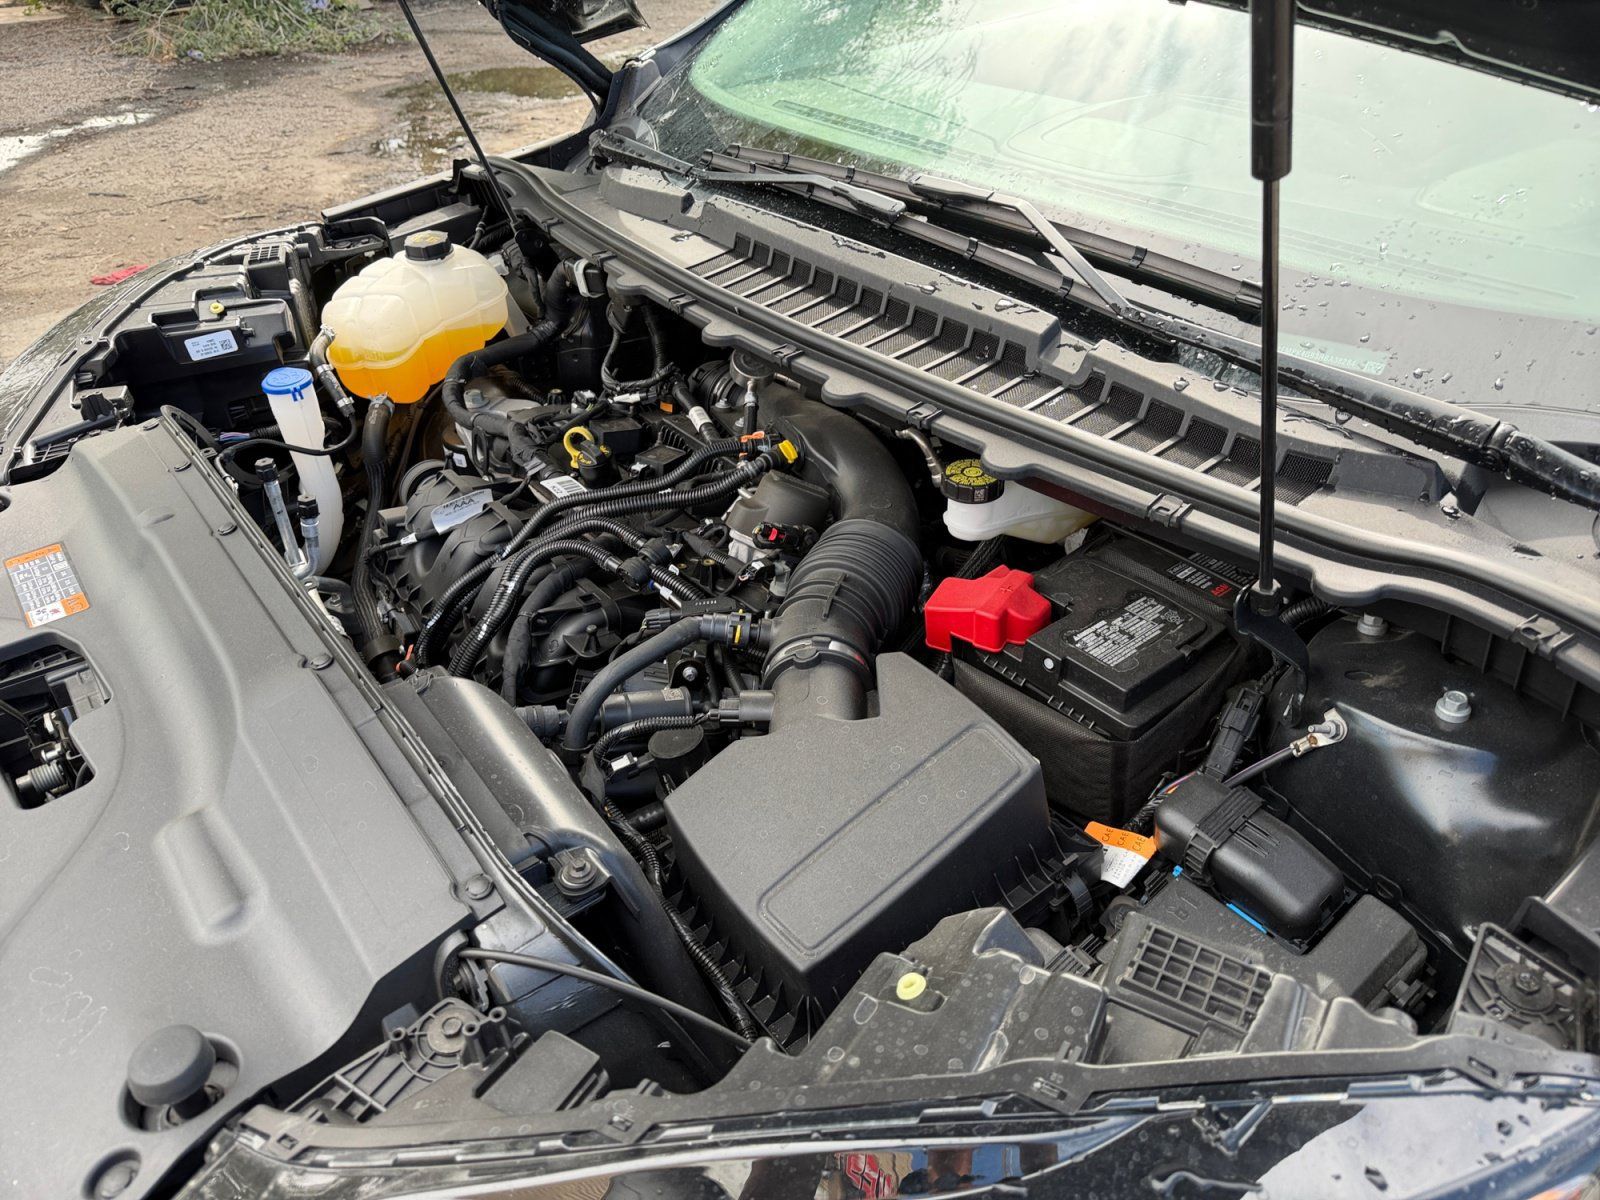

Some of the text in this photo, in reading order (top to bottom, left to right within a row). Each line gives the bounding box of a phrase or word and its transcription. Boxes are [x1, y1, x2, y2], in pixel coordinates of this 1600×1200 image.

[453, 497, 475, 510] AAA
[1101, 827, 1114, 843] CAE
[1116, 831, 1129, 847] CAE
[1131, 836, 1147, 852] CAE
